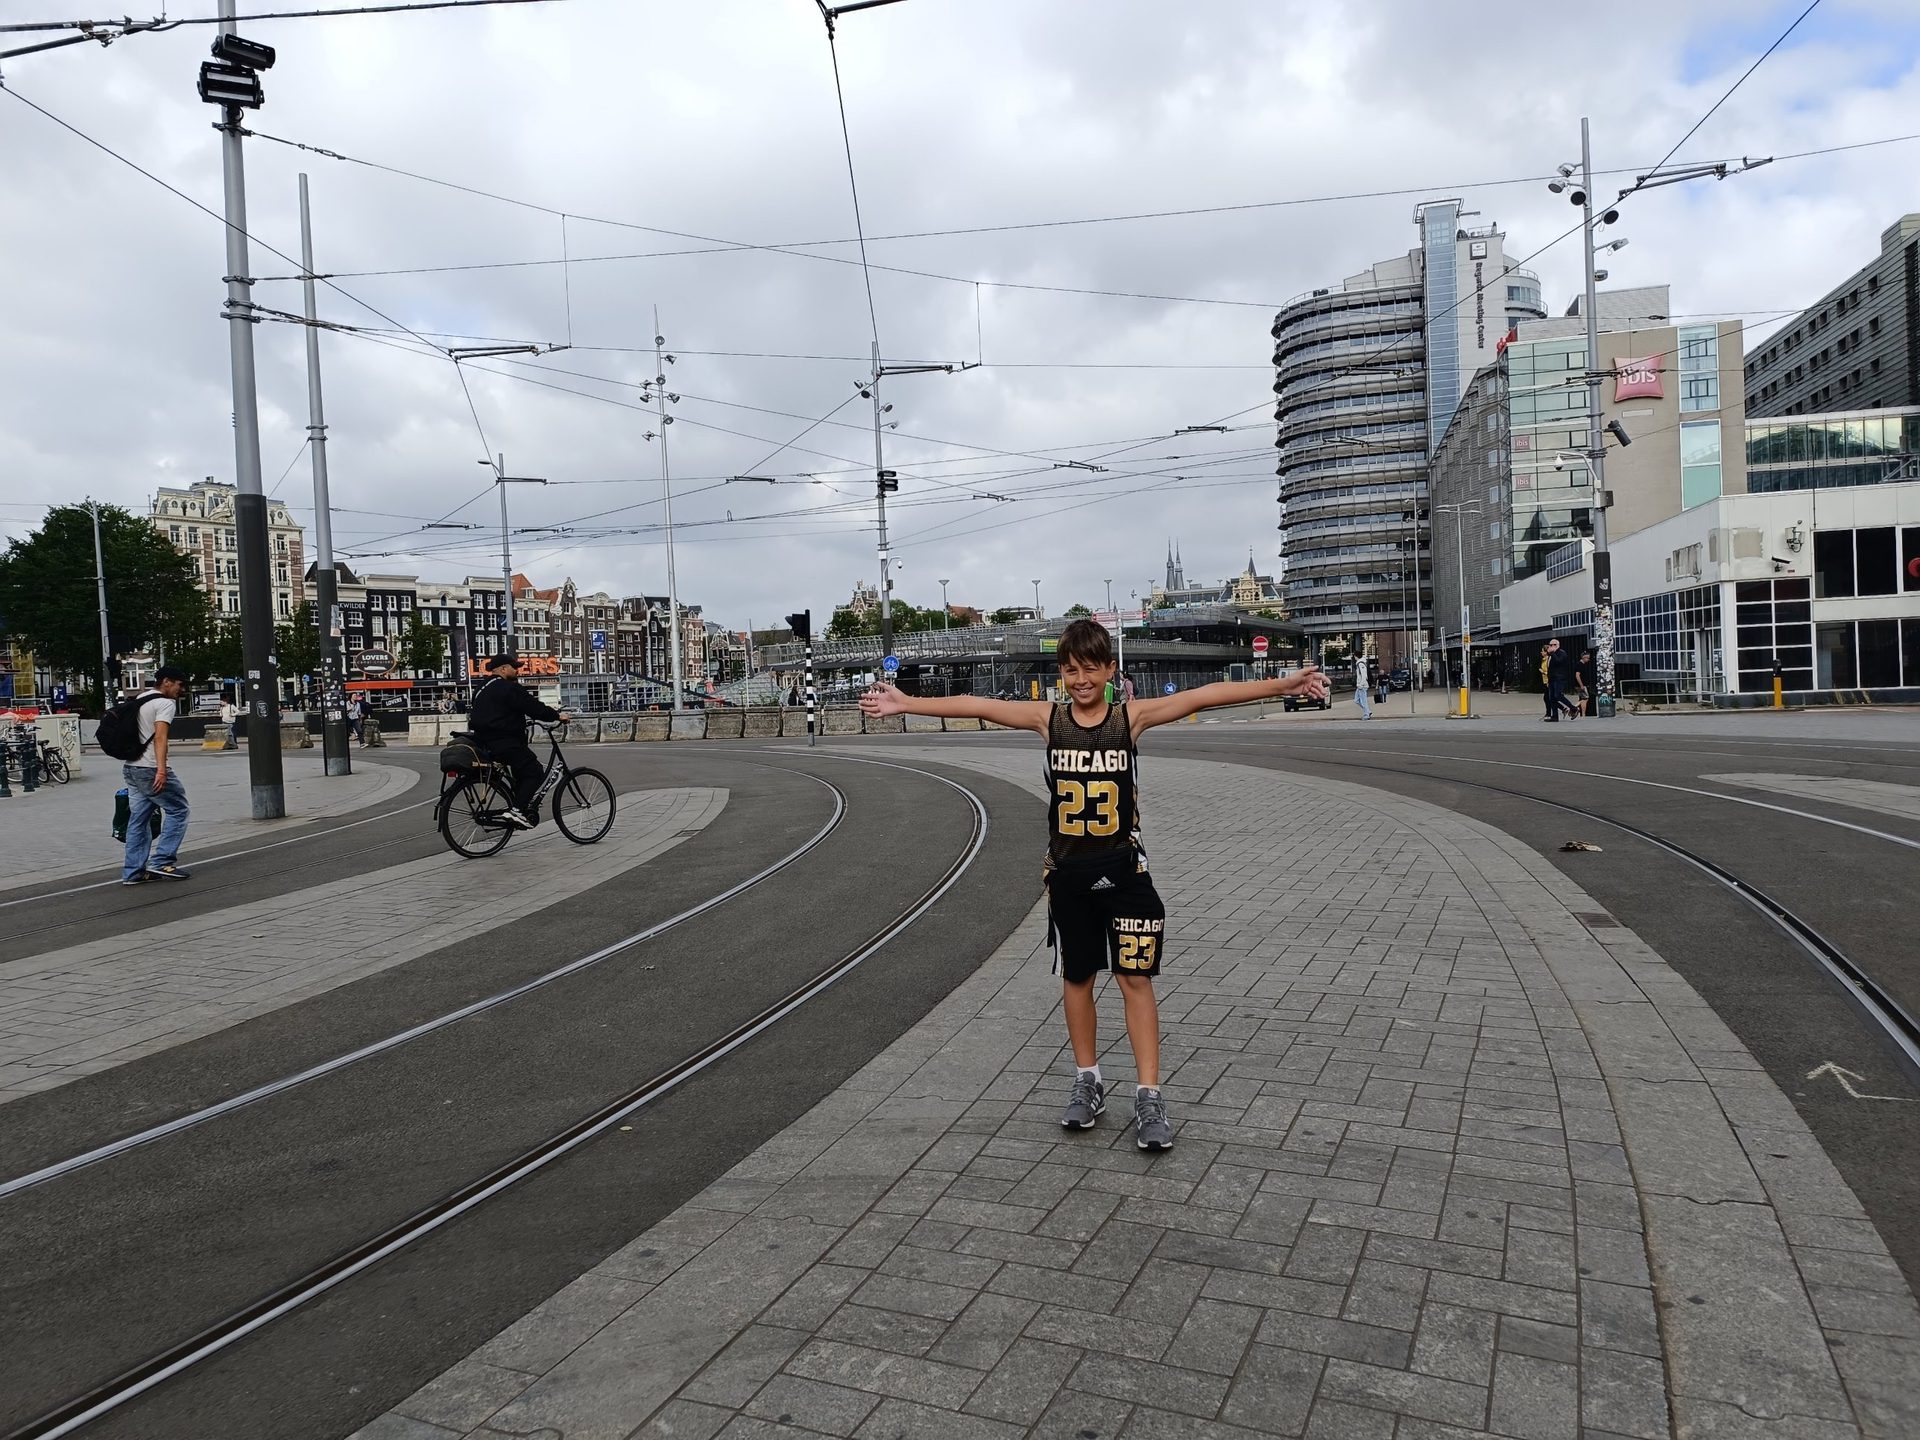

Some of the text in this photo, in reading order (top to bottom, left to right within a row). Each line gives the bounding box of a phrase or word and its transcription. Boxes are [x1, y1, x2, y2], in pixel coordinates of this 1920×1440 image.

[1476, 293, 1485, 324] Meeting
[469, 657, 559, 676] LOERS
[1051, 749, 1128, 773] CHICAGO
[1056, 779, 1120, 836] 23
[1119, 934, 1156, 969] 23
